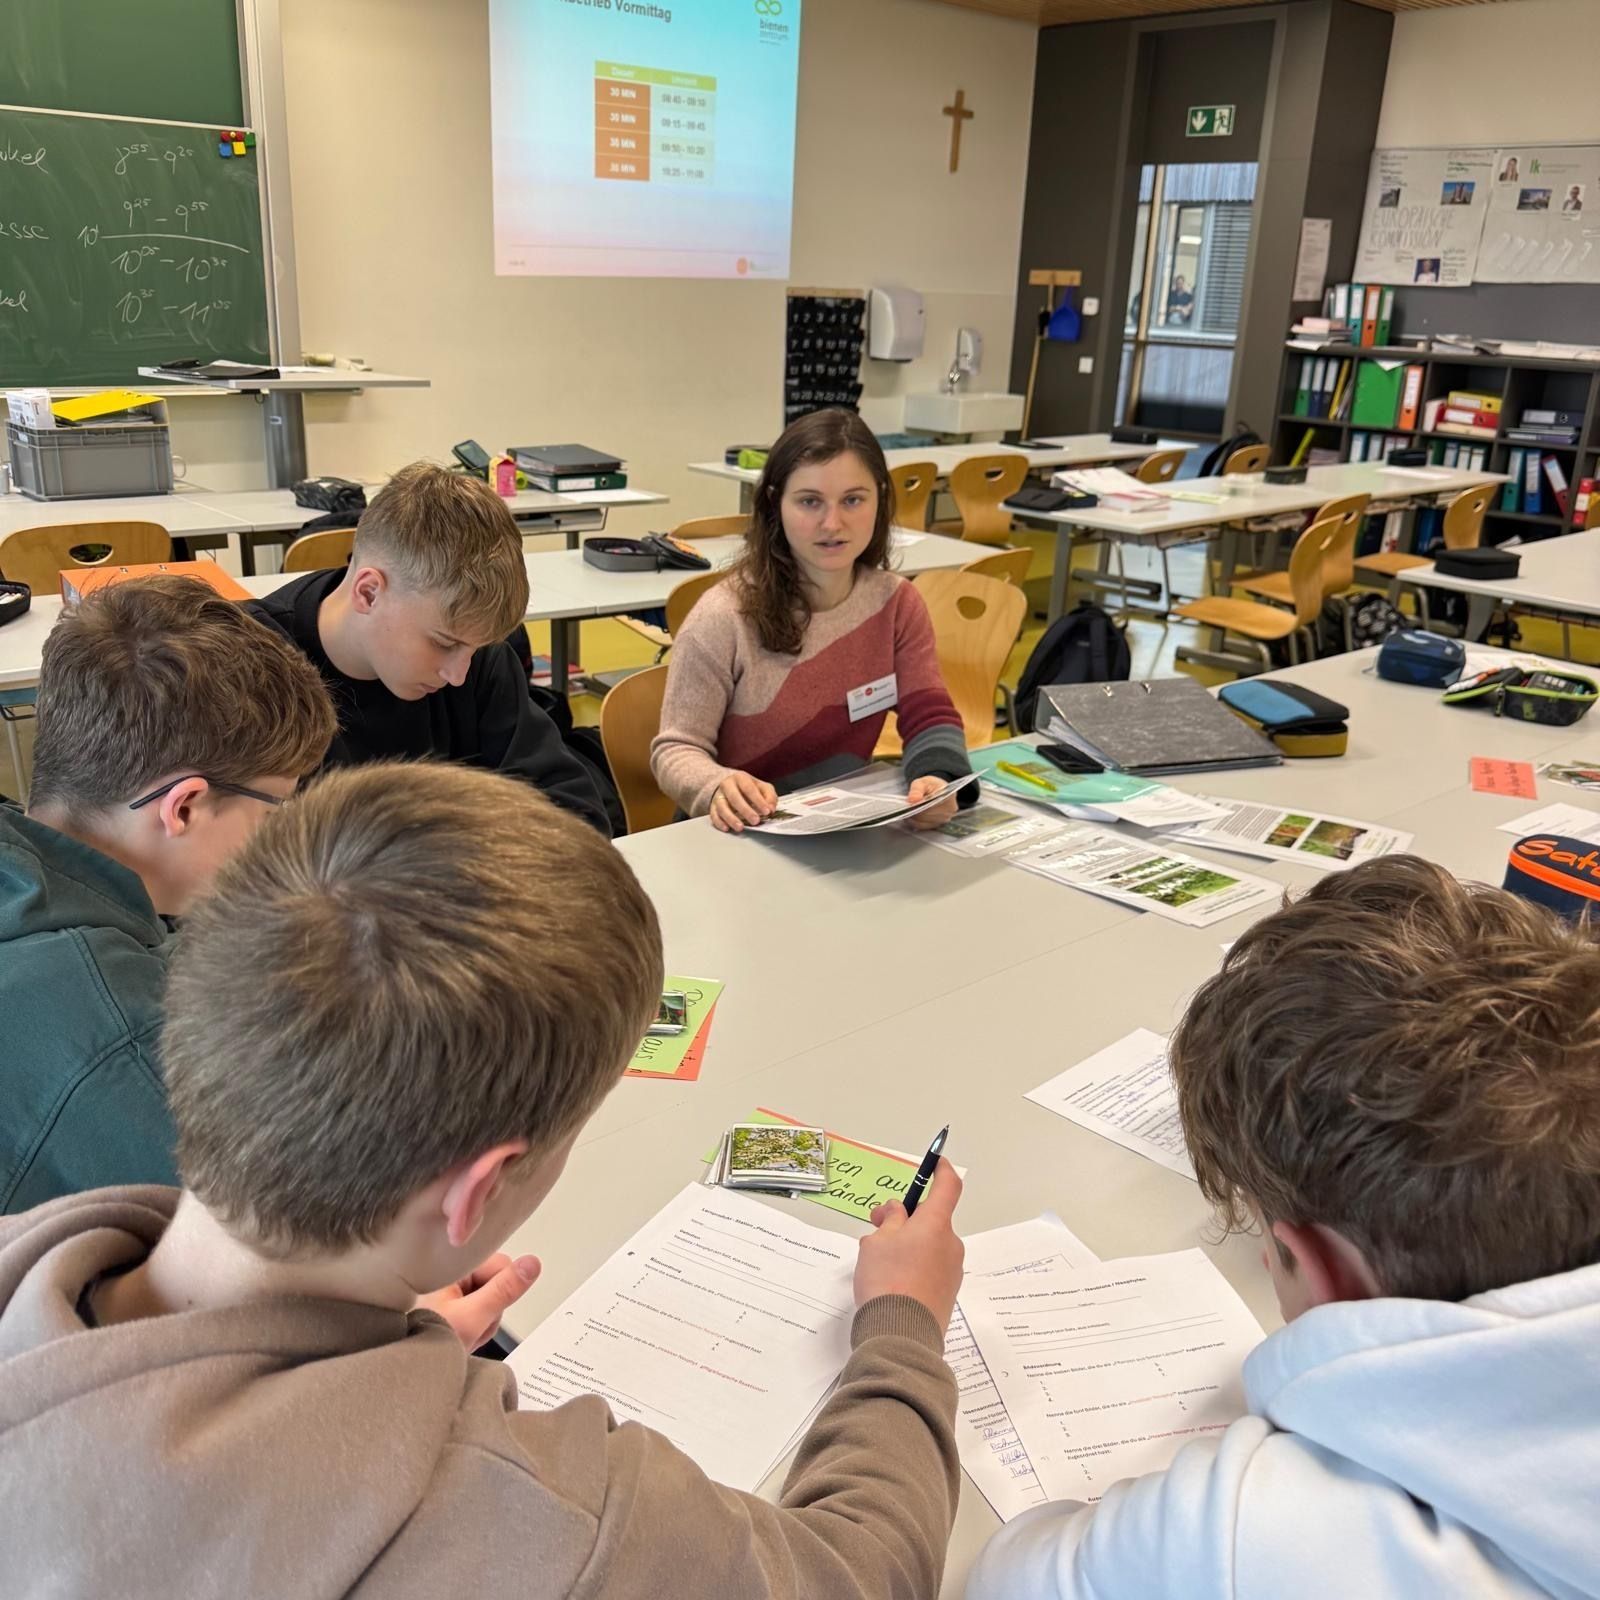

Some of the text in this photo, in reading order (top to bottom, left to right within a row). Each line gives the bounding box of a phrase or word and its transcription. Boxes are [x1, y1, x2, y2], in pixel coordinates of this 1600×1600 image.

[615, 0, 672, 23] Vormittag
[827, 1157, 908, 1193] zen au
